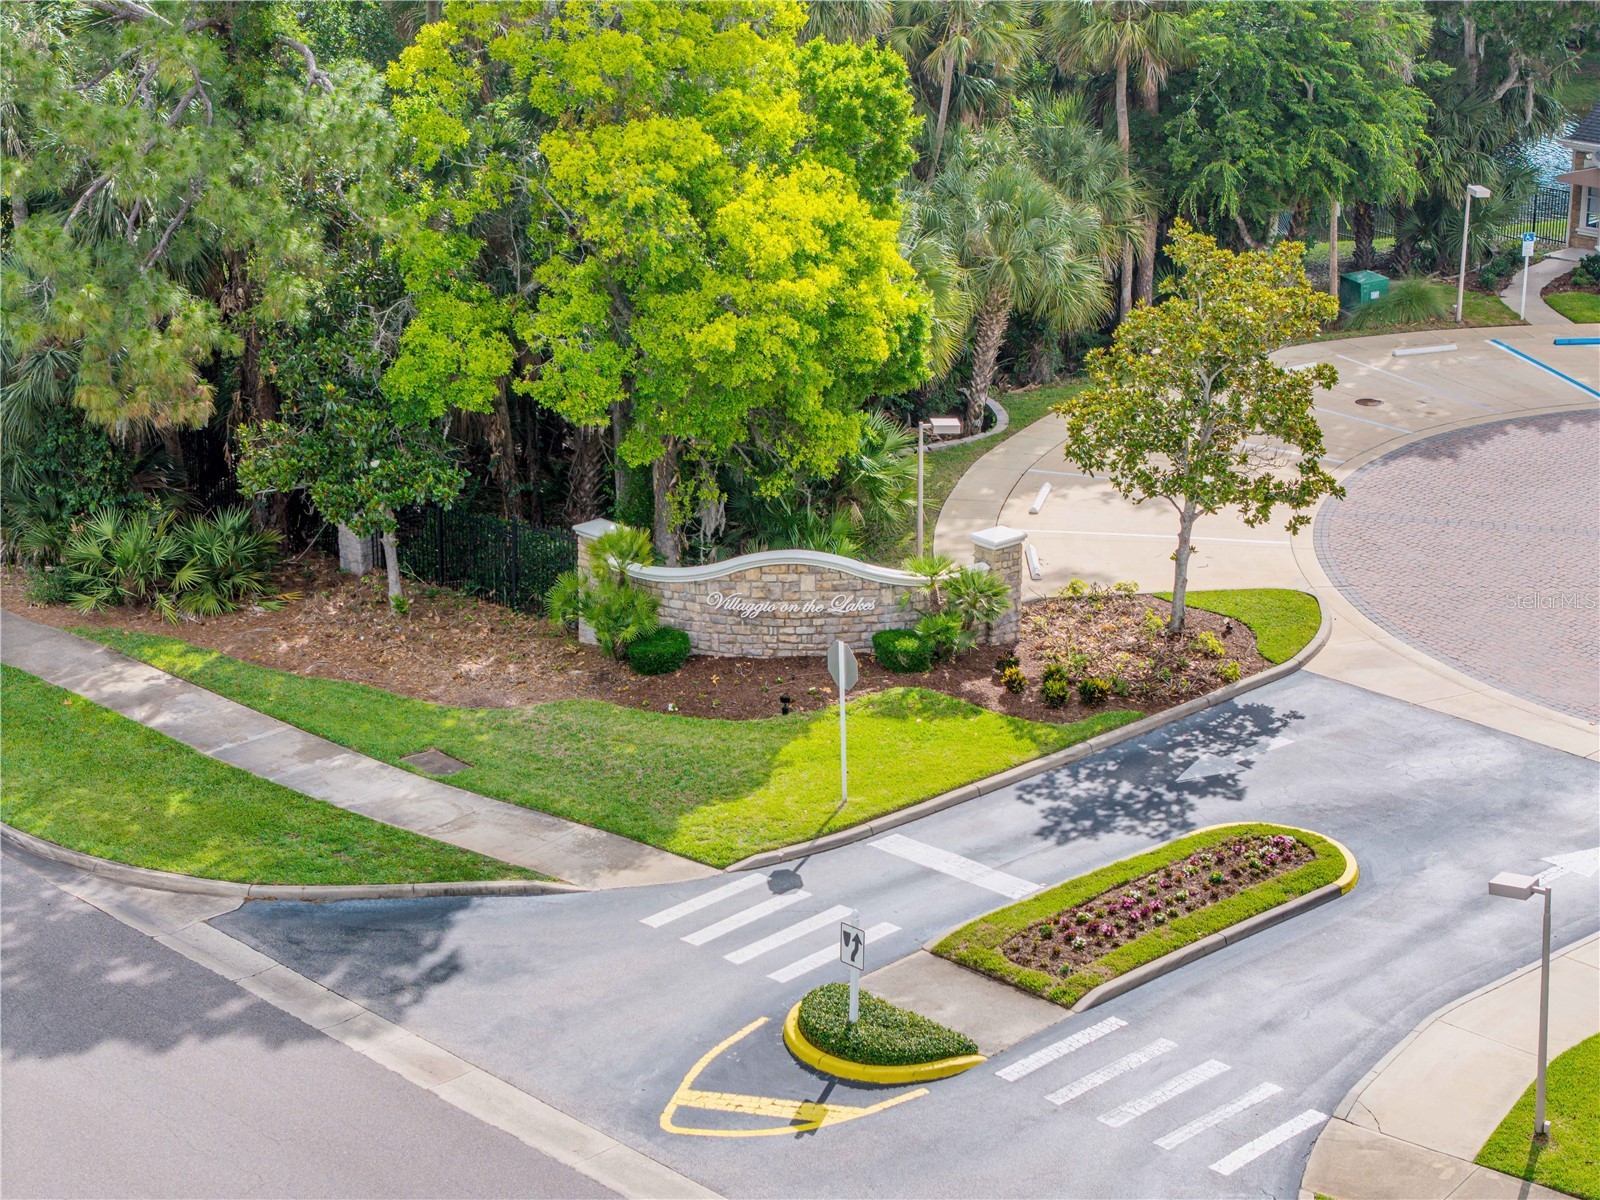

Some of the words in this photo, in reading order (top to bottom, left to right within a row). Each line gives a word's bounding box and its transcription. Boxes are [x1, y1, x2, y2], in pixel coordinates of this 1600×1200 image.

[707, 592, 777, 618] Villaggio
[780, 602, 799, 612] on
[802, 599, 824, 613] the
[828, 594, 876, 613] Lakes
